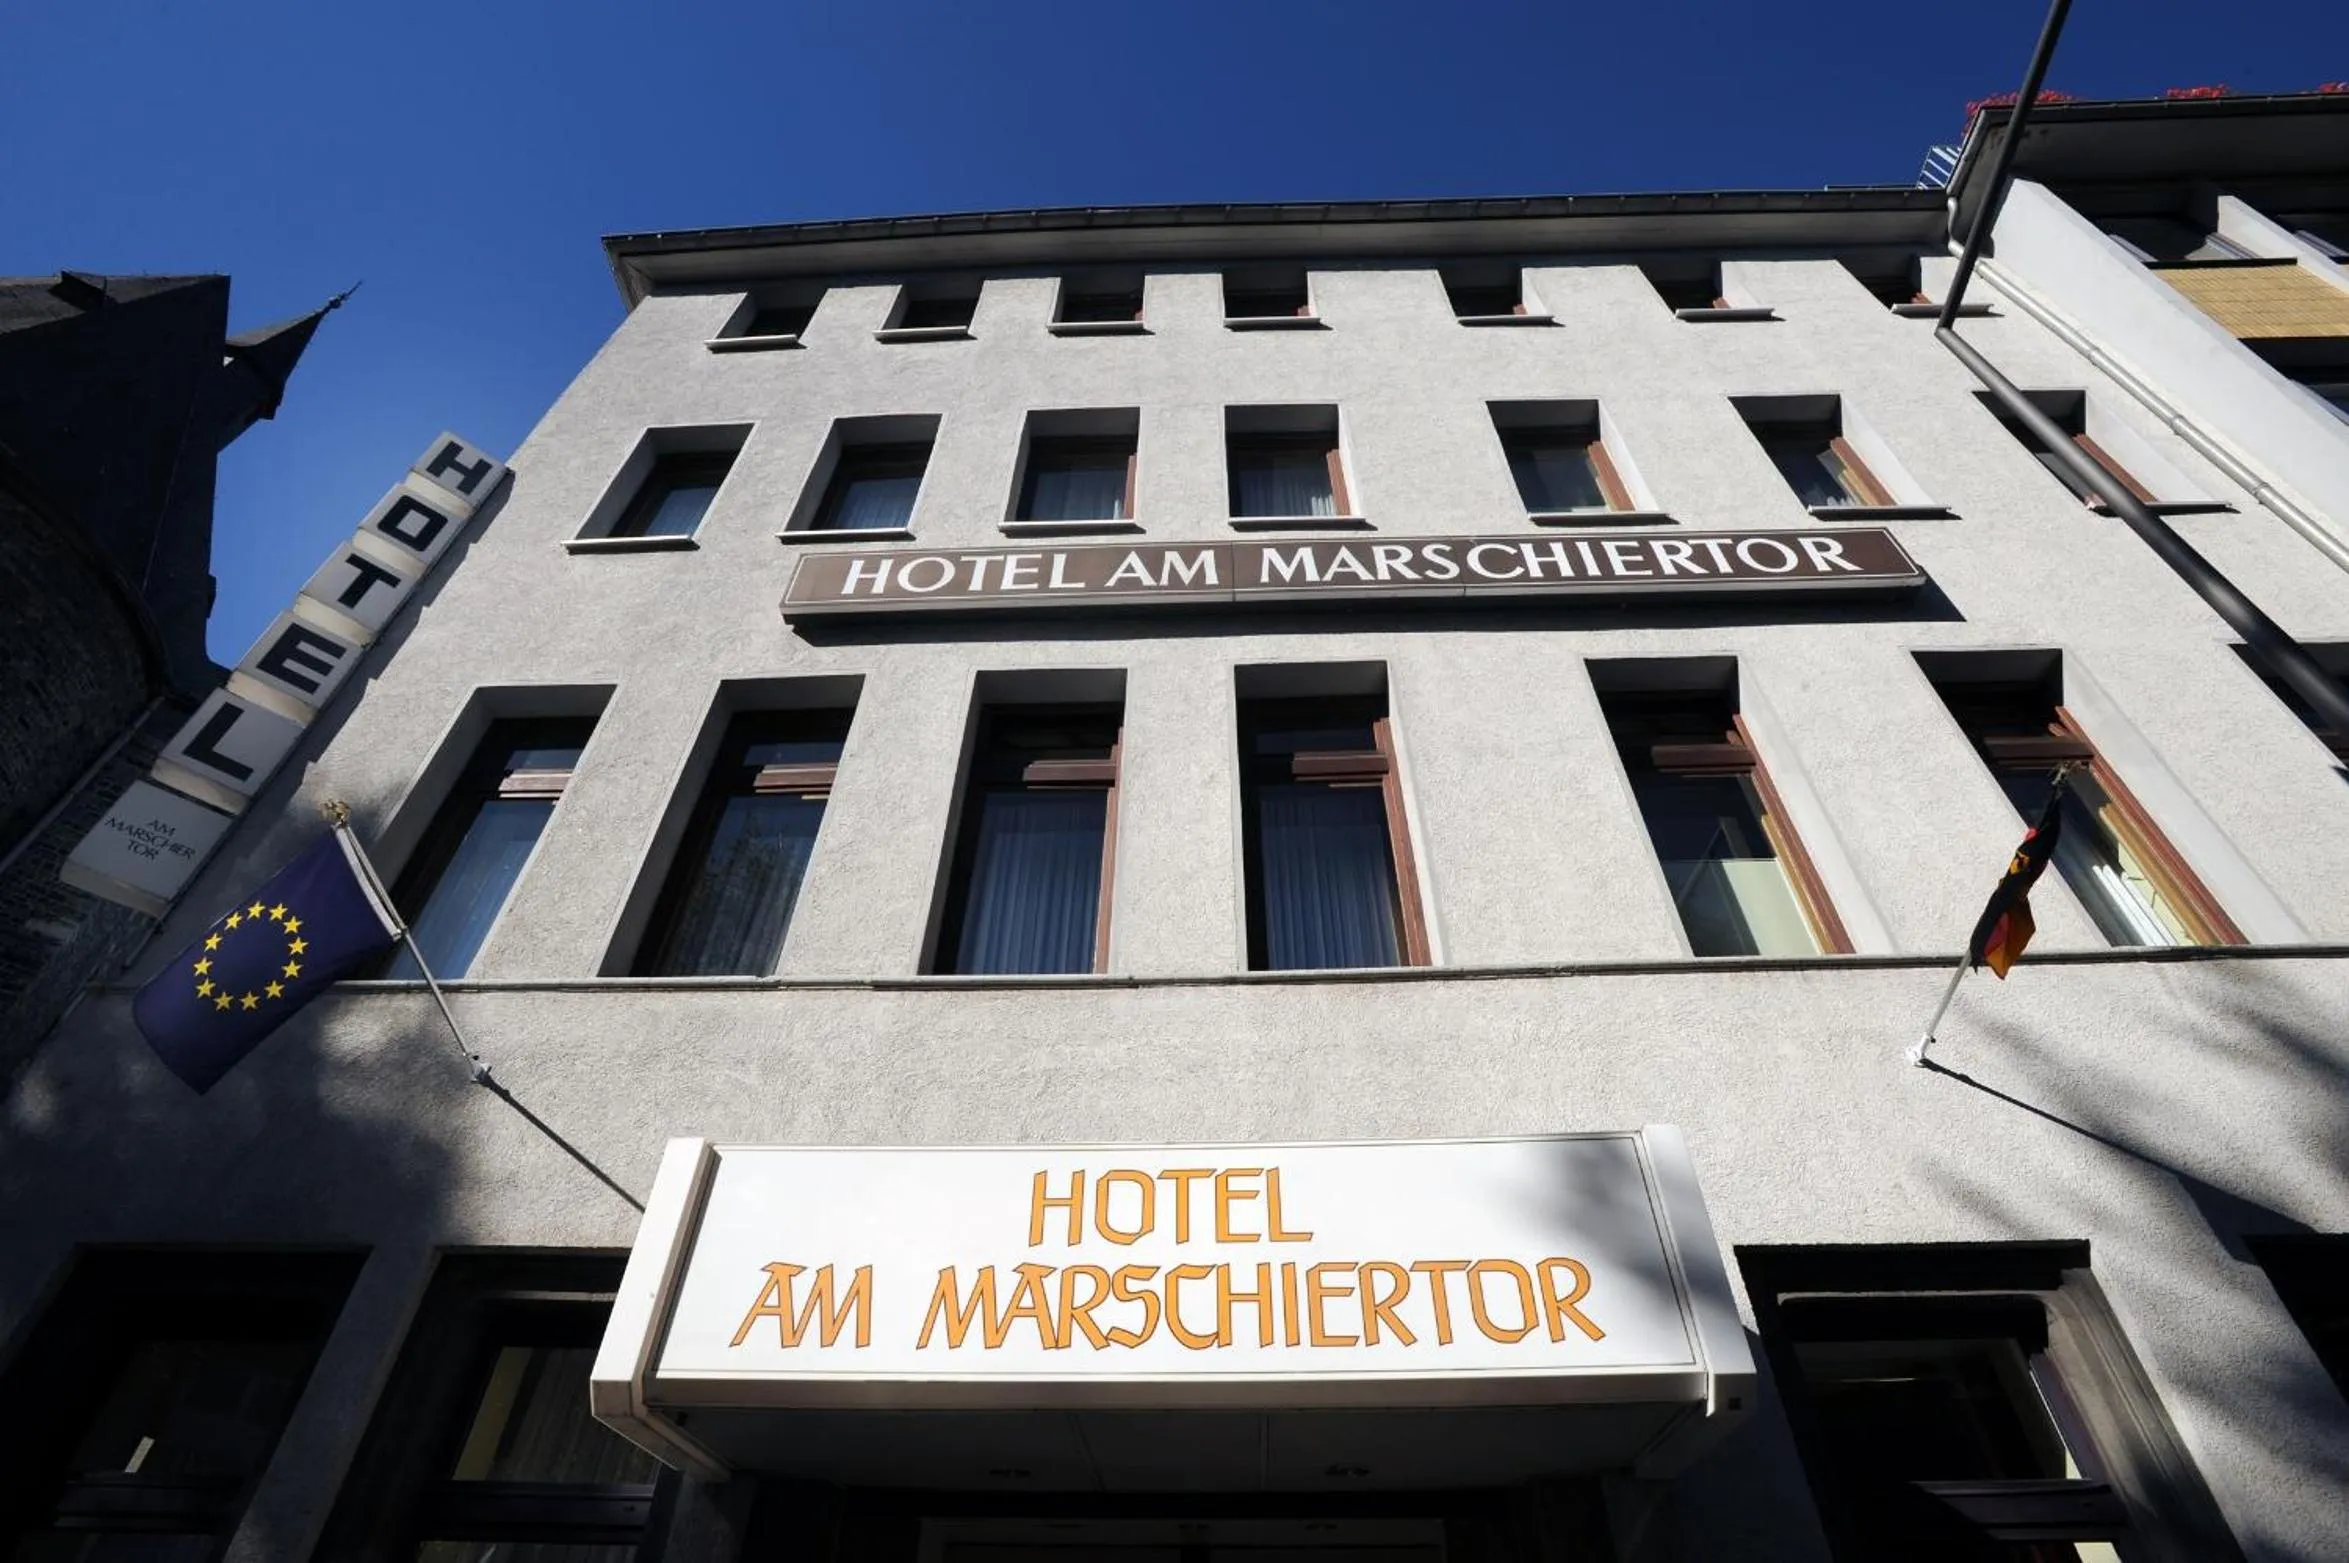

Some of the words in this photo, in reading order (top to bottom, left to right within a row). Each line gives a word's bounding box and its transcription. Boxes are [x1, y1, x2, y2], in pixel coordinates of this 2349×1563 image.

[840, 552, 1086, 595] HOTEL
[1103, 547, 1220, 588] AM
[1259, 537, 1865, 584] MARSCHIERTOR
[184, 441, 493, 782] HOTEL
[104, 817, 197, 860] MARSCHIER
[128, 839, 159, 861] TOR
[147, 819, 176, 837] AM
[1028, 1166, 1314, 1248] HOTEL
[731, 1261, 873, 1349] AM
[915, 1257, 1607, 1351] MARSCHIERTOR
